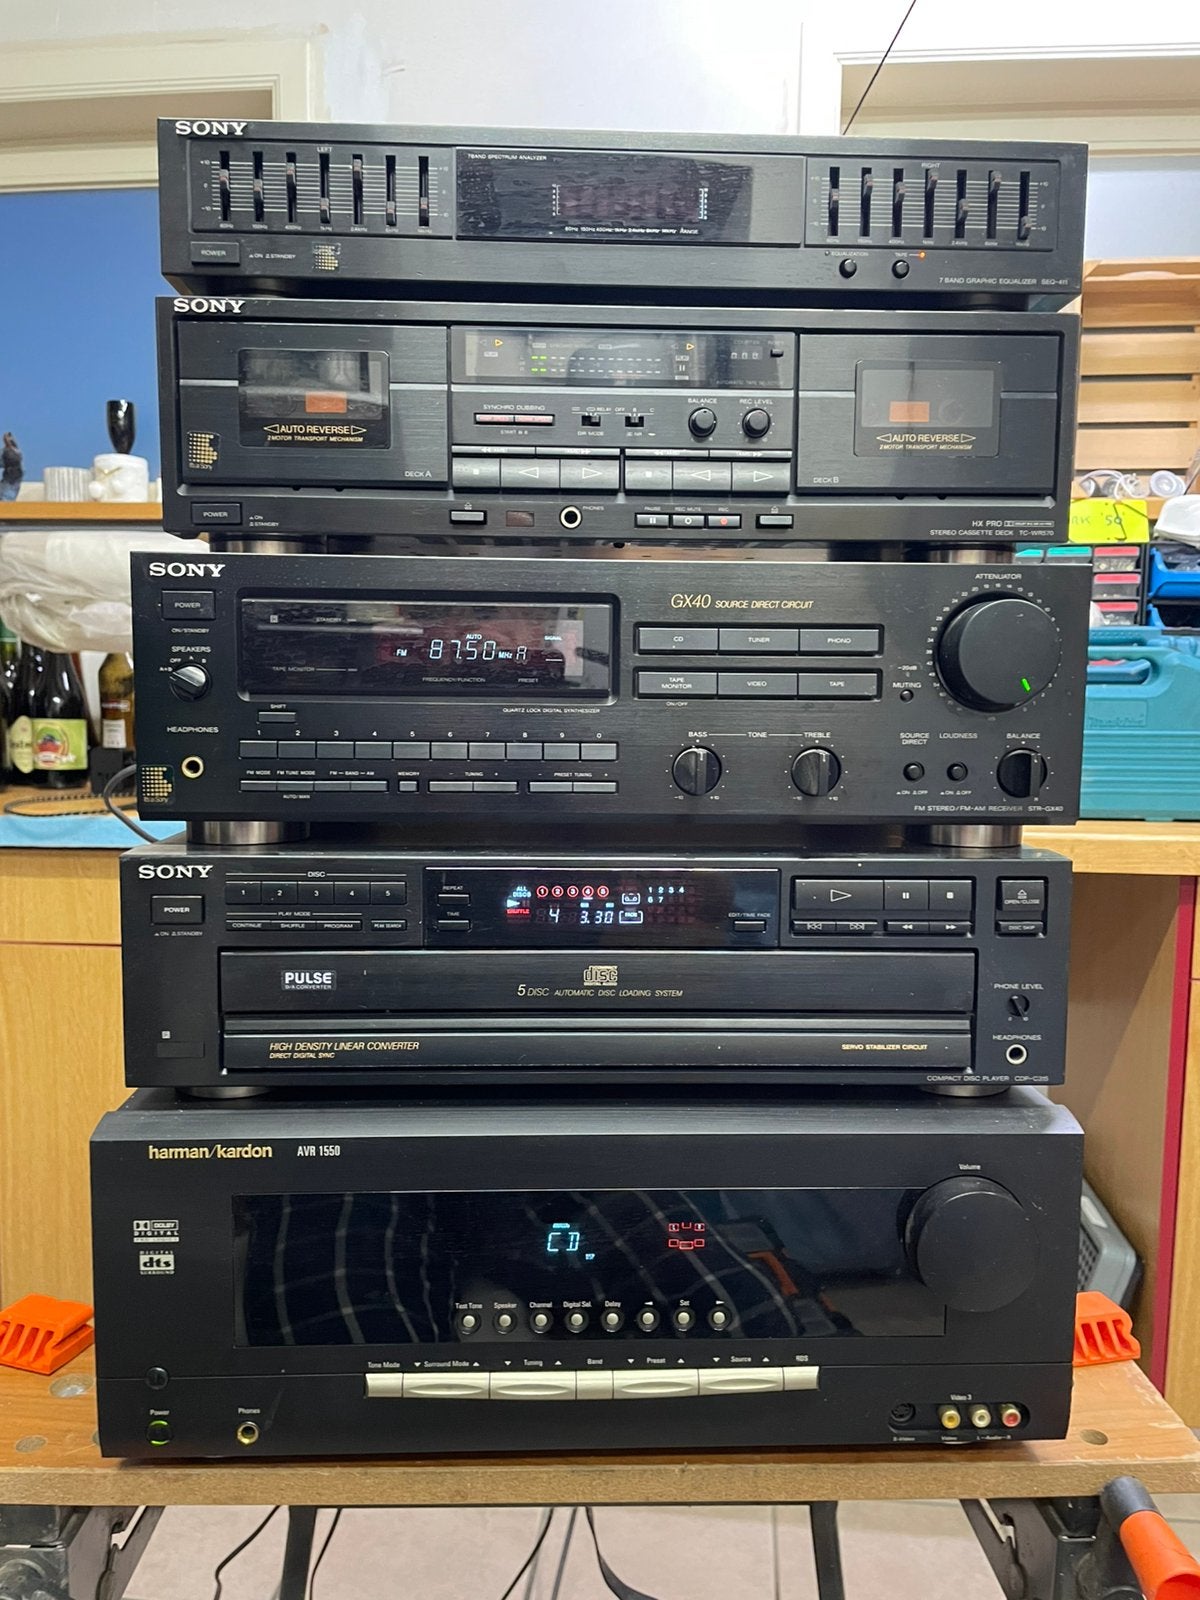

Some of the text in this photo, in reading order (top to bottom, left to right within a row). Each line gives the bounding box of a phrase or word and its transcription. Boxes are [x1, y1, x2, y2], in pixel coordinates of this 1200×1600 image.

[175, 121, 248, 136] SONY
[966, 278, 998, 286] GRAPHIC
[173, 298, 246, 314] SONY
[280, 424, 351, 435] AUTO REVERSE
[892, 434, 960, 442] AUTO REVERSE
[425, 470, 433, 478] A
[833, 476, 840, 484] B
[149, 562, 226, 578] SONY
[670, 593, 814, 609] GX40 SOURCE DIRECT CIRCUIT
[498, 652, 513, 660] MHz
[167, 726, 219, 734] HEADPHONES
[138, 864, 214, 880] SONY
[550, 908, 560, 924] 4
[285, 972, 332, 984] PULSE
[517, 984, 526, 996] 5
[527, 988, 550, 996] DISC
[270, 1042, 420, 1050] HIGH DENSITY LINEAR CONVERTER
[148, 1144, 272, 1160] harman/kardon
[297, 1145, 341, 1157] AVR 1550
[547, 1232, 580, 1252] CD
[142, 1256, 171, 1268] dts
[563, 1300, 580, 1309] Digital
[605, 1300, 621, 1309] Delay
